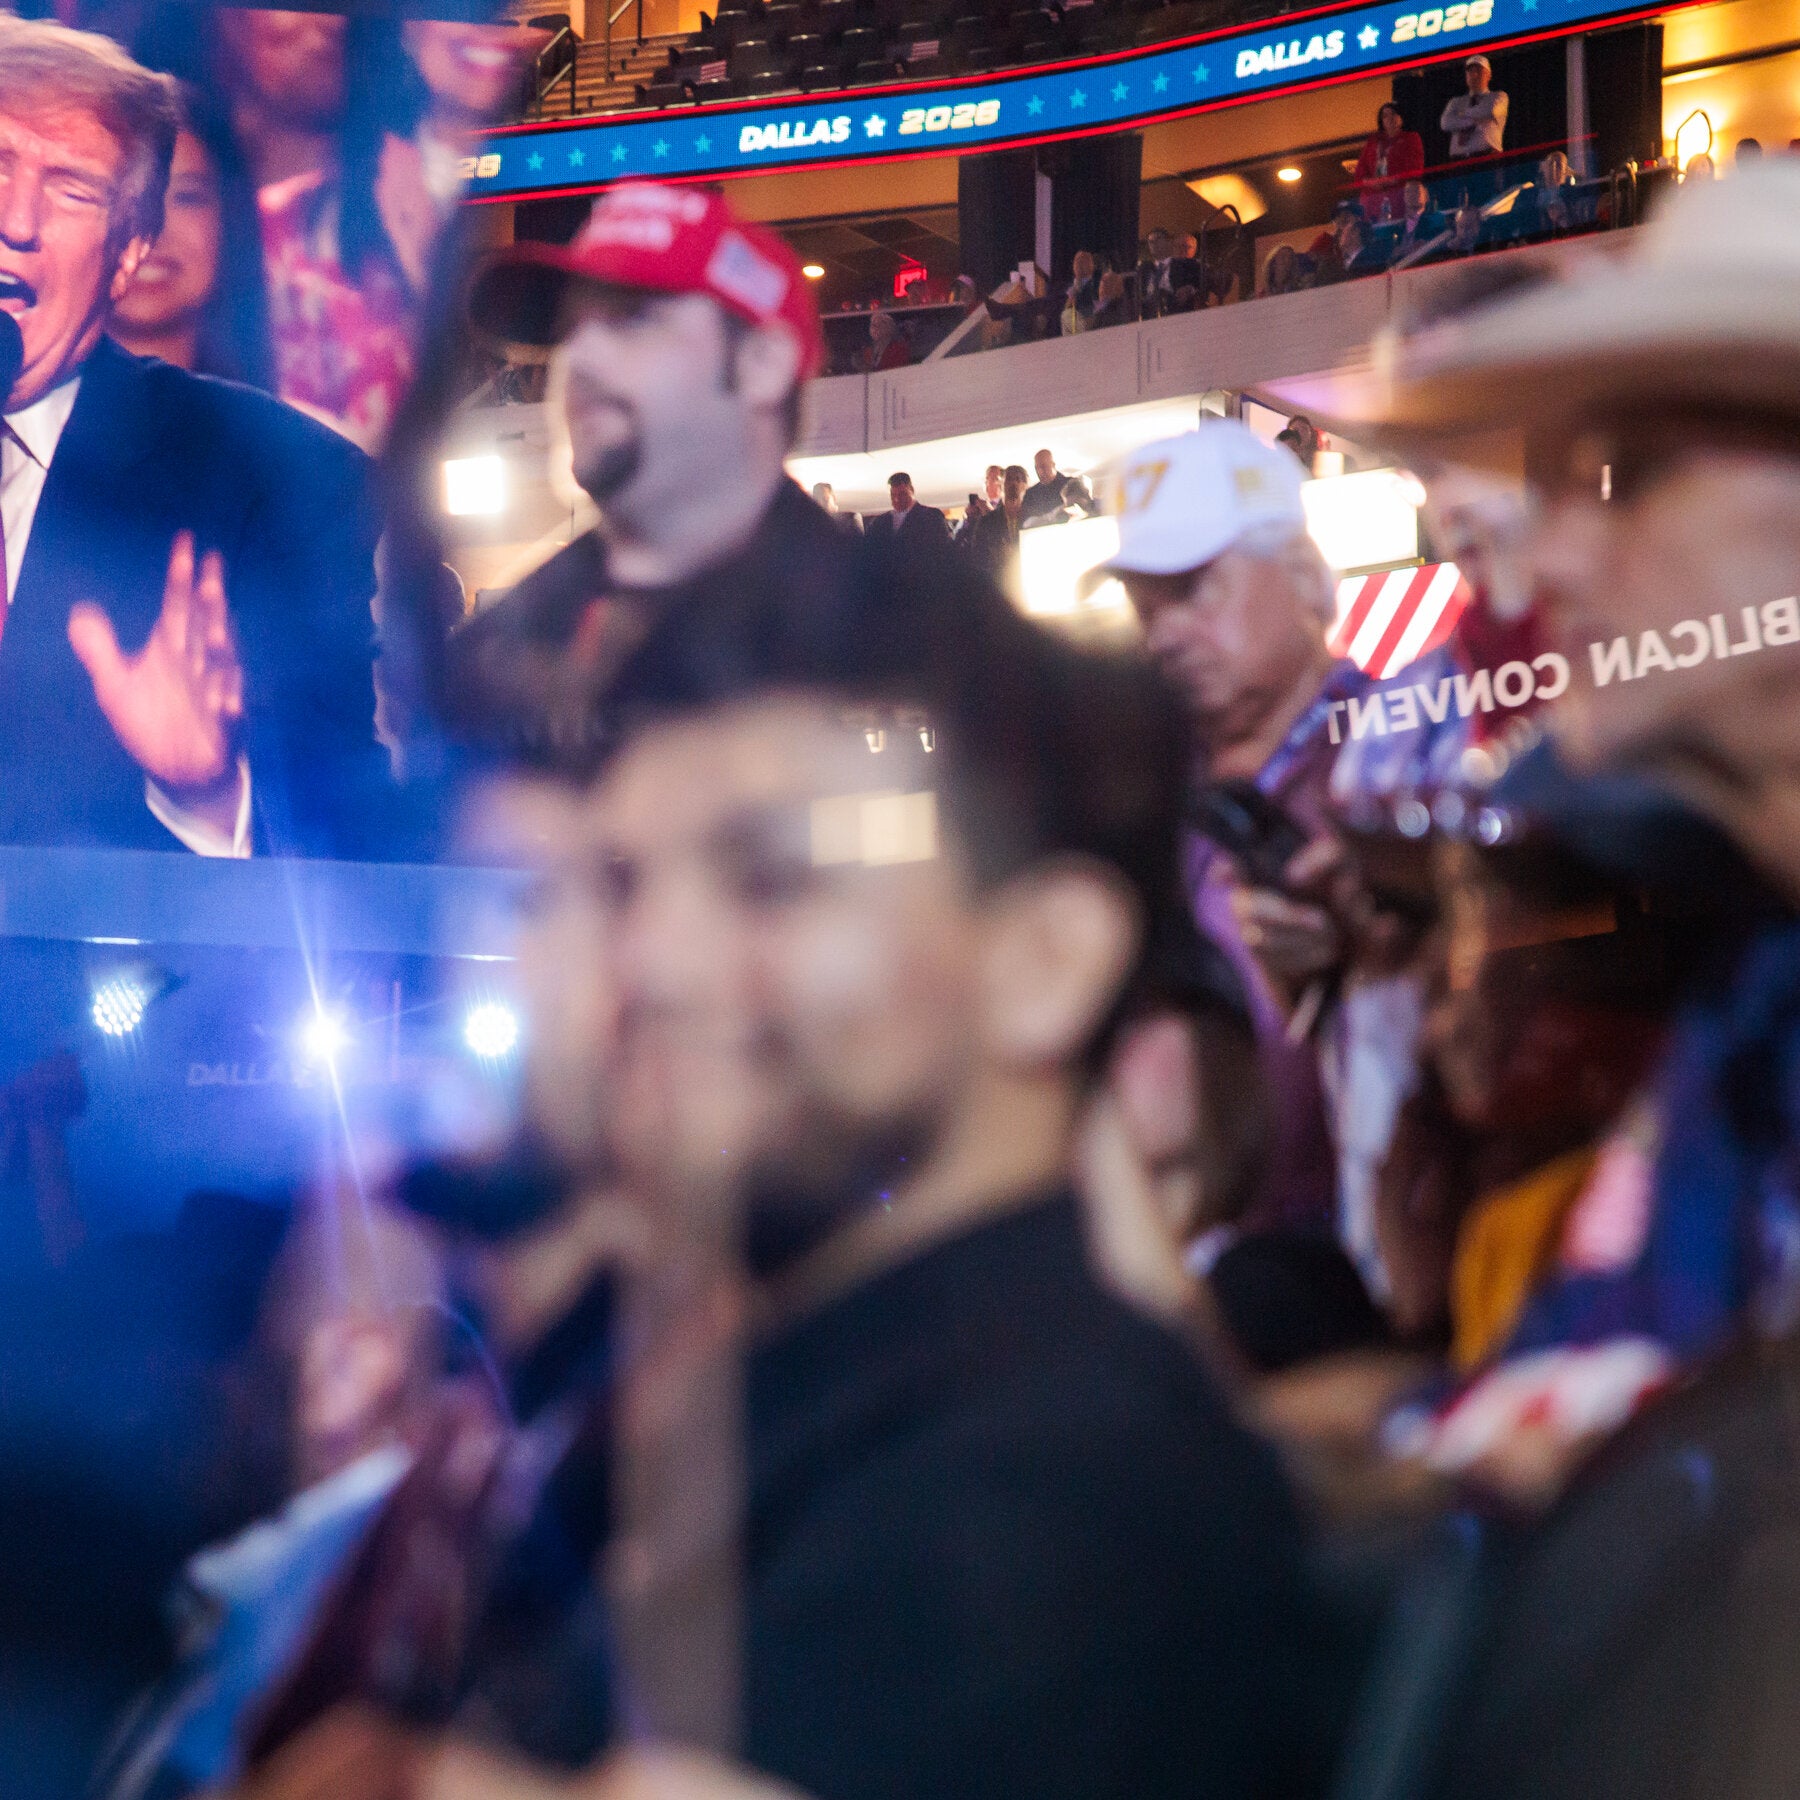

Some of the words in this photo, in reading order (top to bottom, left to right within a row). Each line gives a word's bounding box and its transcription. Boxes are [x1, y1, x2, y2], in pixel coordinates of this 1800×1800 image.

[1235, 29, 1345, 78] DALLAS
[1390, 0, 1495, 43] 2026
[739, 115, 852, 153] DALLAS
[898, 98, 1001, 135] 2026
[456, 153, 501, 179] 26
[187, 1060, 302, 1087] DALL
